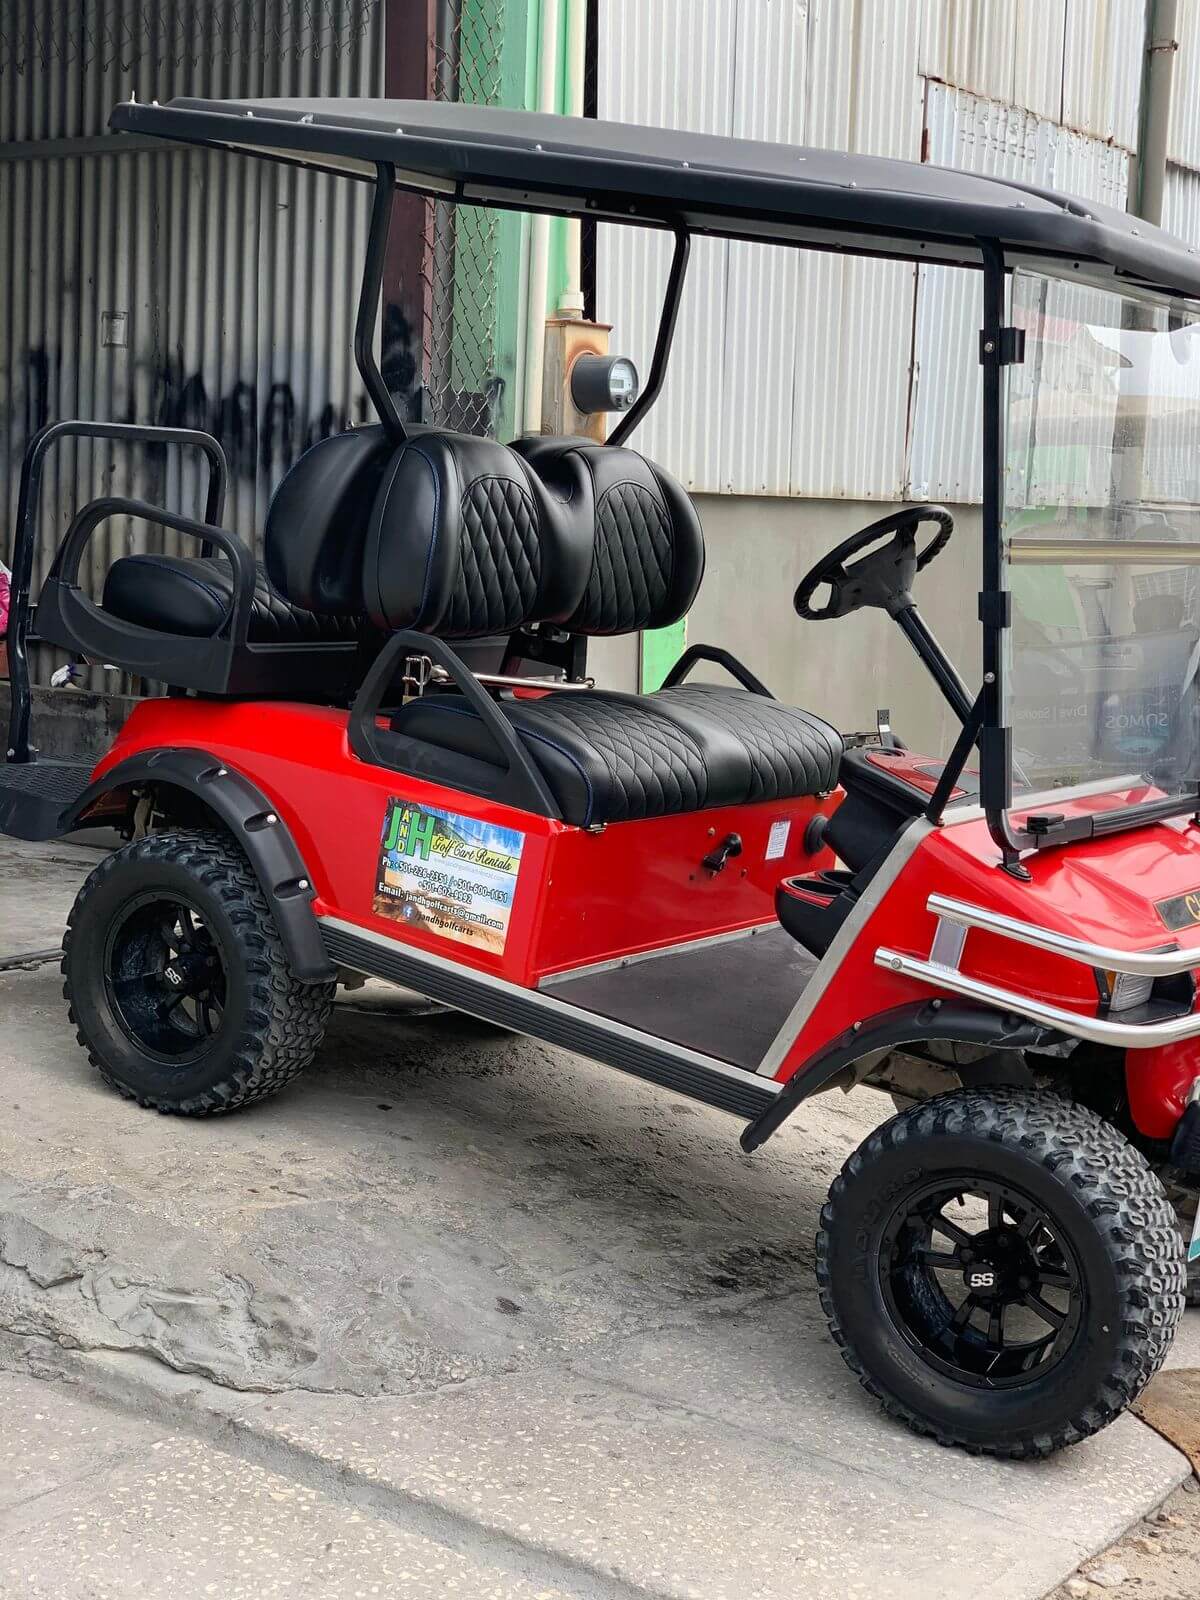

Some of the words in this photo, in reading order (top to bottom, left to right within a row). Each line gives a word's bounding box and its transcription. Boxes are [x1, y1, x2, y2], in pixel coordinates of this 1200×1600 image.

[433, 836, 455, 858] Golf
[453, 841, 476, 861] Cart
[475, 847, 512, 871] Rentals
[378, 881, 405, 900] Email:
[405, 890, 504, 930] jandhgolfcarts@gmail.com
[969, 1271, 995, 1288] SS
